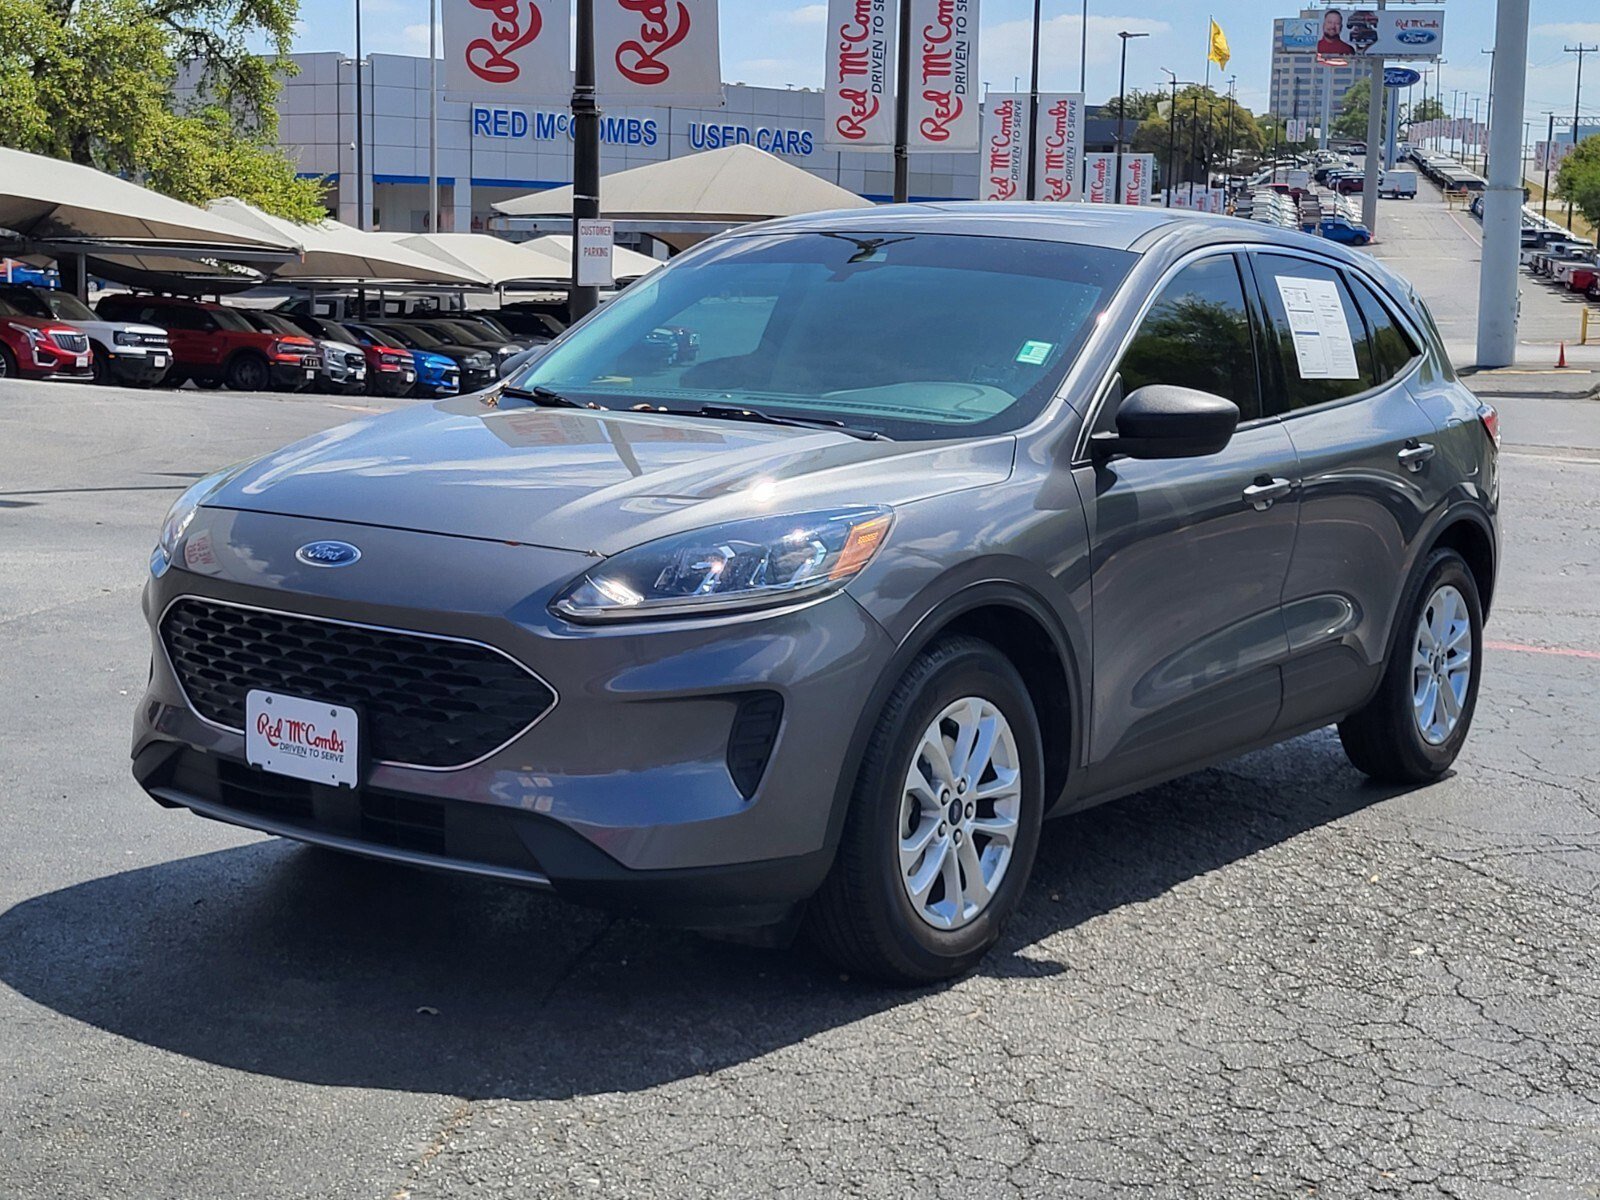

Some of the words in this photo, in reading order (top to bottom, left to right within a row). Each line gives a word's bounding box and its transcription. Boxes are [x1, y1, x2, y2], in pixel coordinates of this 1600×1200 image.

[872, 16, 885, 35] TO
[956, 16, 968, 36] TO
[871, 40, 884, 93] DRIVEN
[955, 41, 967, 94] DRIVEN
[474, 108, 528, 138] RED
[536, 112, 657, 146] McMBS
[836, 89, 879, 140] Red
[919, 90, 963, 142] Red
[1013, 100, 1022, 129] SERVE
[1067, 100, 1077, 129] SERVE
[691, 123, 750, 149] USED
[757, 128, 813, 155] CARS
[990, 99, 1013, 174] McCombs
[1012, 130, 1022, 143] TO
[1045, 99, 1067, 174] McCombs
[1066, 130, 1075, 143] TO
[1011, 149, 1021, 181] DRIVEN
[1065, 149, 1075, 181] DRIVEN
[580, 225, 612, 236] CUSTOMER
[583, 246, 609, 257] PARKING
[307, 545, 346, 561] Ford
[257, 712, 282, 747] Red
[285, 718, 344, 753] McCombs
[280, 742, 307, 755] DRIVEN
[309, 747, 320, 758] TO
[321, 751, 344, 764] SERVE
